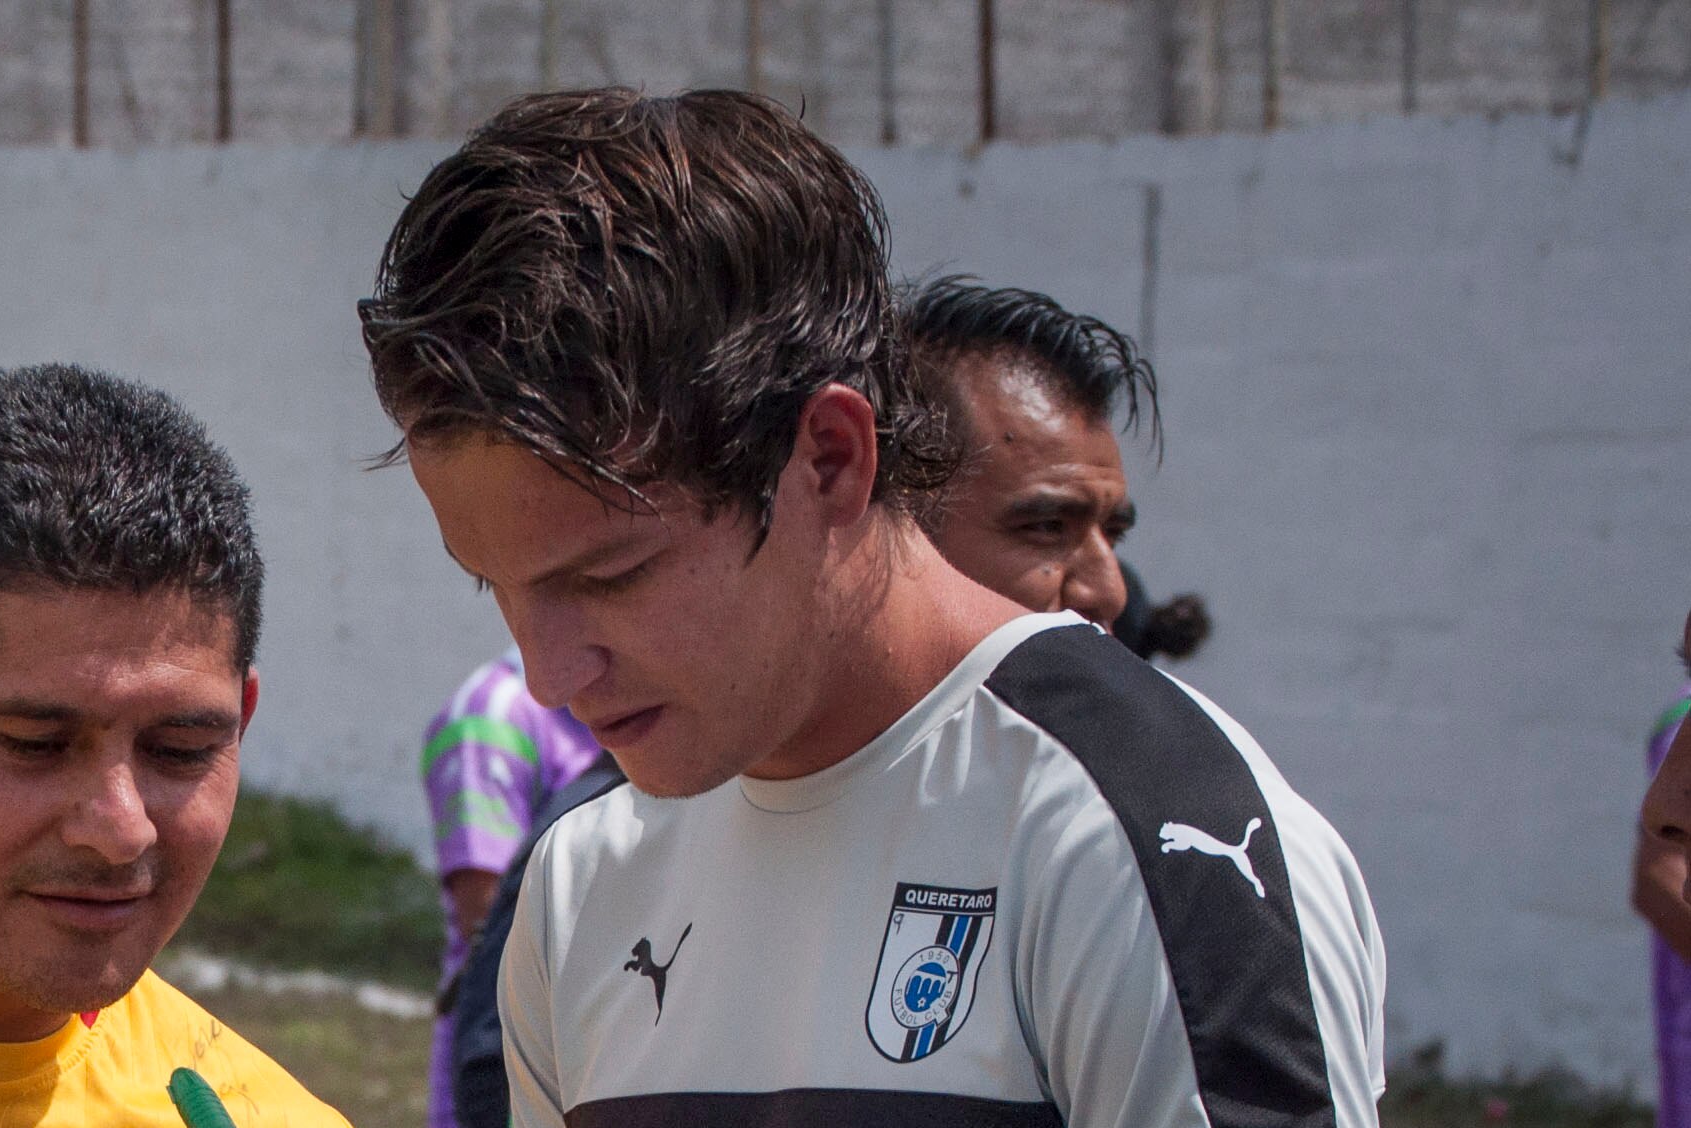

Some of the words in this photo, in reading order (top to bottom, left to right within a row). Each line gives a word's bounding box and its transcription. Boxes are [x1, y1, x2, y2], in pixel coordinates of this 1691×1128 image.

[905, 889, 993, 909] QUERETARO
[919, 951, 950, 964] 1950
[894, 988, 918, 1025] FUTBOL
[924, 990, 953, 1020] CLUB
